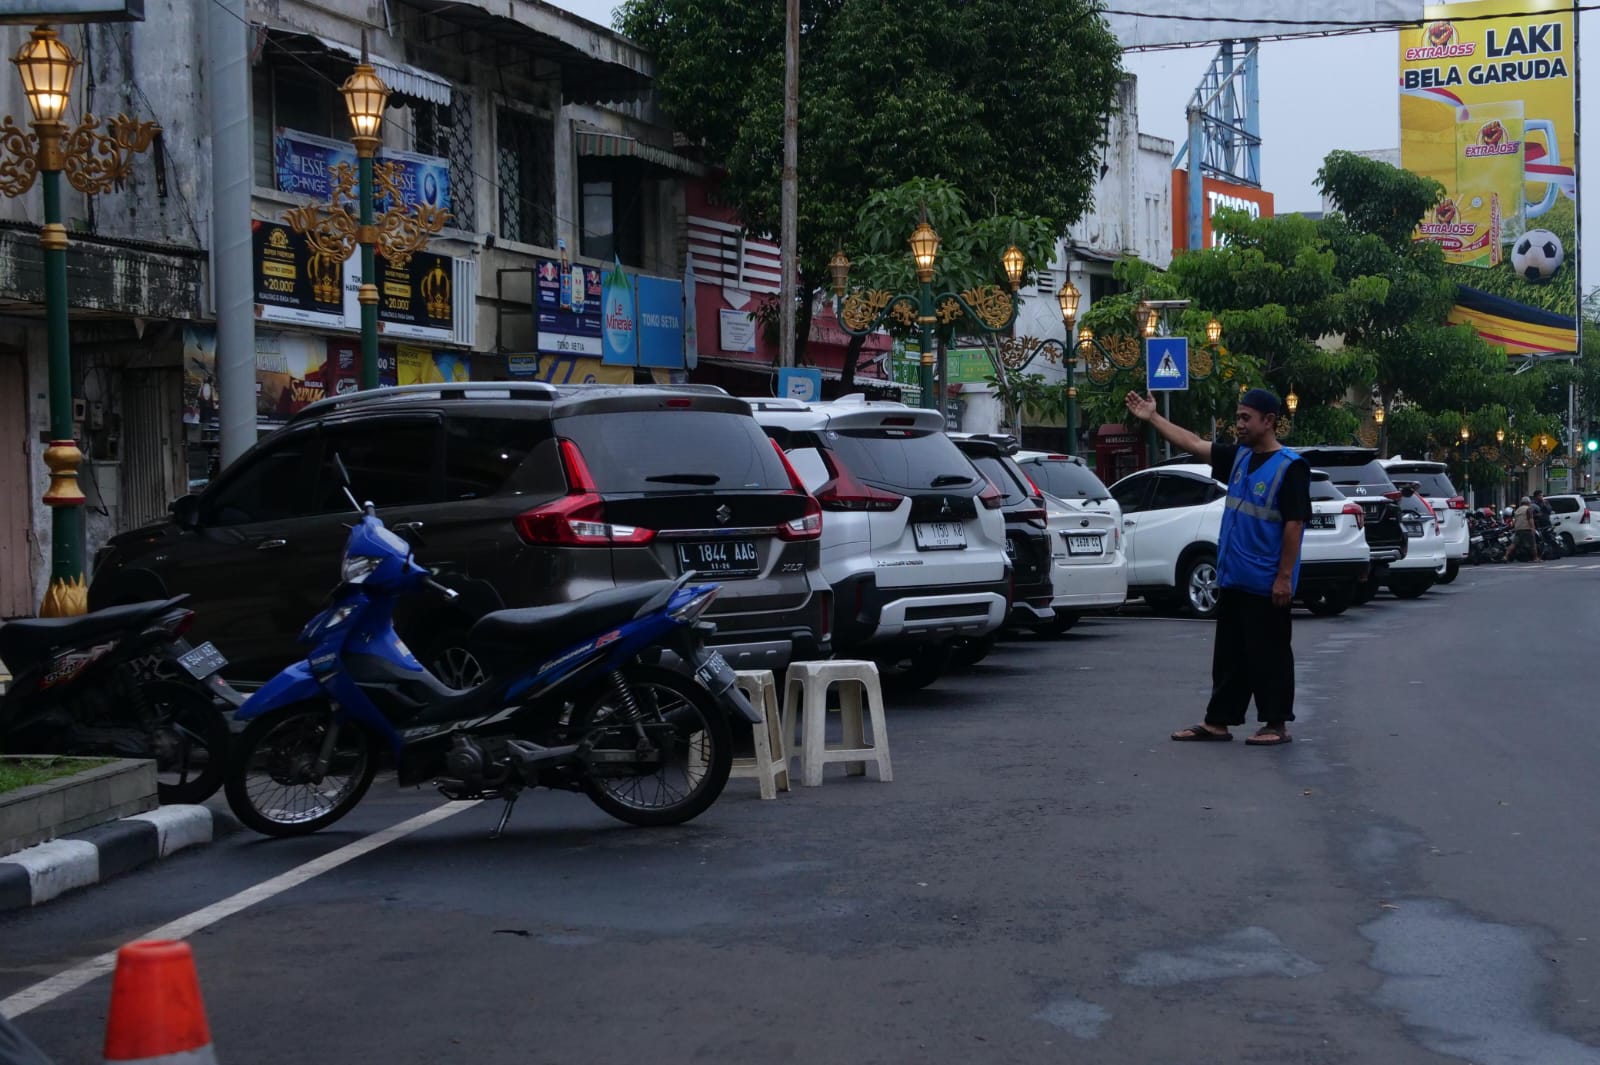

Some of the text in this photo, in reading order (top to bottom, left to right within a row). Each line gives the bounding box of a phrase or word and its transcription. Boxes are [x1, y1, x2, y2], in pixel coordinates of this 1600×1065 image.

[1486, 23, 1562, 58] LAKI
[1405, 43, 1476, 61] EXTRAJOSS
[1404, 57, 1568, 90] BELA GARUDA
[1465, 141, 1521, 157] EXTRAJOSS
[301, 157, 328, 178] ESSE
[291, 175, 328, 193] CHANGE
[1420, 223, 1477, 236] EXTRAJOSS
[615, 299, 623, 316] Le
[606, 313, 633, 331] Minerale
[642, 313, 680, 329] TOKO SETIA
[681, 543, 756, 563] L 1844 AAG
